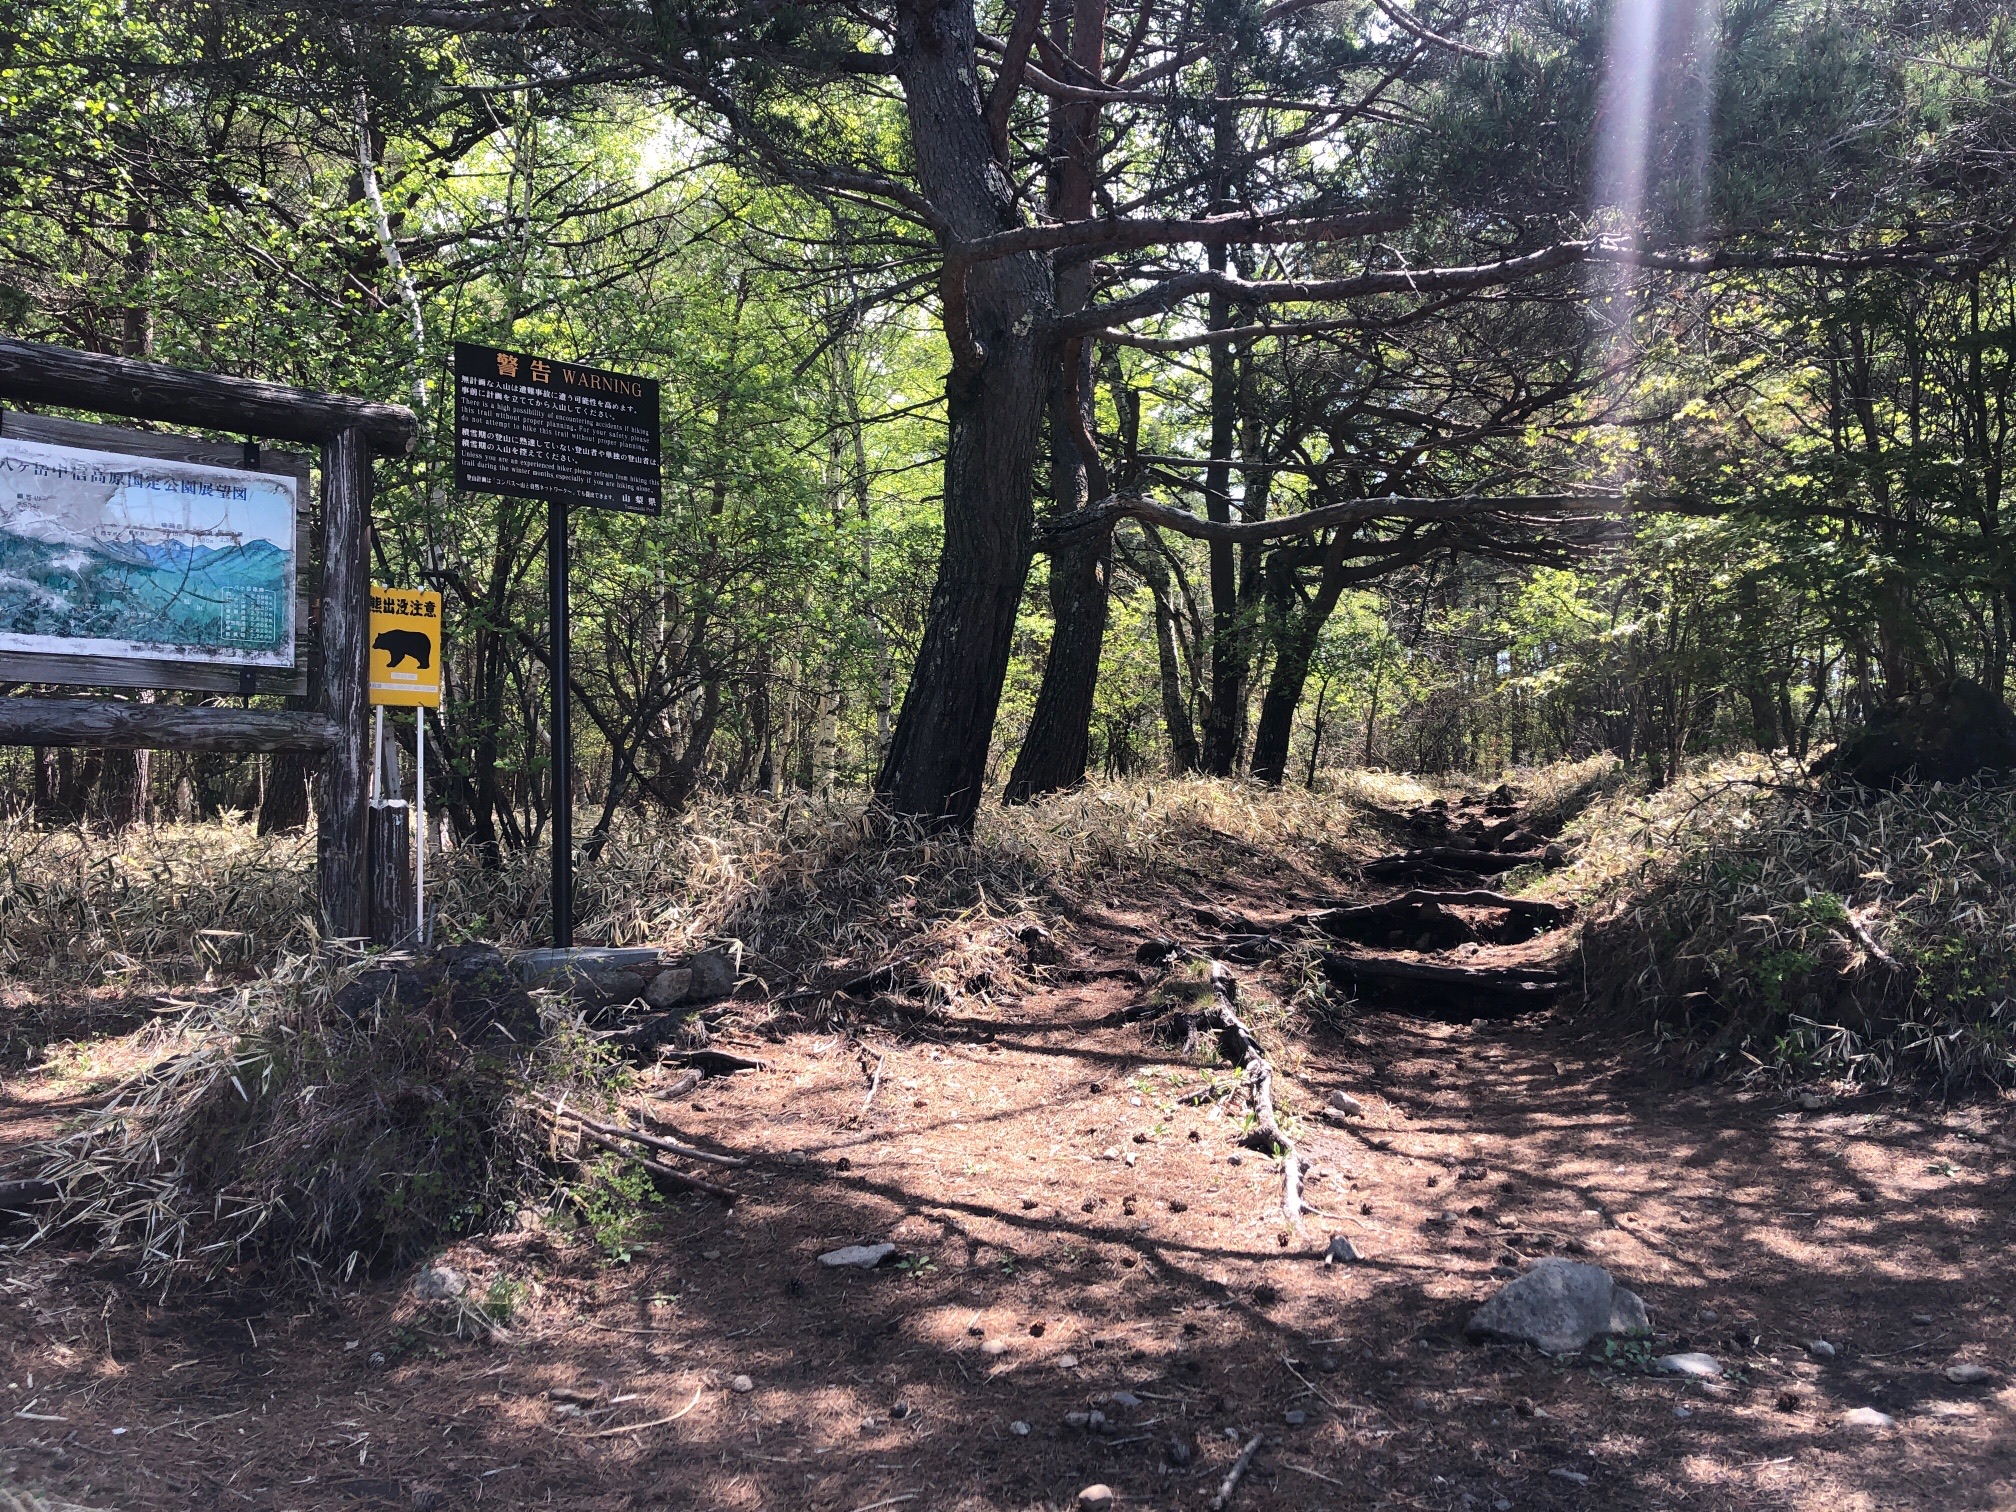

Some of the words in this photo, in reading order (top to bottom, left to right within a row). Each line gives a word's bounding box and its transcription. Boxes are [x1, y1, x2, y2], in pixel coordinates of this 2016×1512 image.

[496, 352, 551, 384] 警告
[562, 368, 641, 397] WARNING
[461, 396, 479, 406] There
[496, 403, 510, 412] high
[512, 405, 543, 418] possibility
[555, 413, 593, 426] encountering
[595, 420, 622, 430] accidents
[631, 426, 648, 436] hiking
[461, 405, 474, 413] this
[477, 408, 492, 416] trail
[495, 411, 519, 421] without
[522, 417, 543, 426] proper
[546, 419, 576, 431] planning.
[630, 433, 649, 443] please
[485, 418, 510, 429] attempt
[522, 424, 536, 432] hike
[571, 432, 594, 441] without
[597, 438, 616, 446] proper
[619, 440, 647, 451] planning.
[461, 449, 482, 459] Unless
[520, 458, 554, 471] experienced
[574, 466, 591, 476] please
[594, 469, 613, 478] refrain
[630, 475, 647, 484] hiking
[648, 477, 659, 485] this
[461, 458, 474, 466] trail
[477, 461, 496, 471] during
[511, 466, 530, 474] winter
[555, 472, 583, 483] especially
[616, 481, 633, 490] hiking
[636, 484, 653, 492] alone.
[622, 493, 656, 506] 山梨県
[370, 596, 436, 617] 熊出没注意
